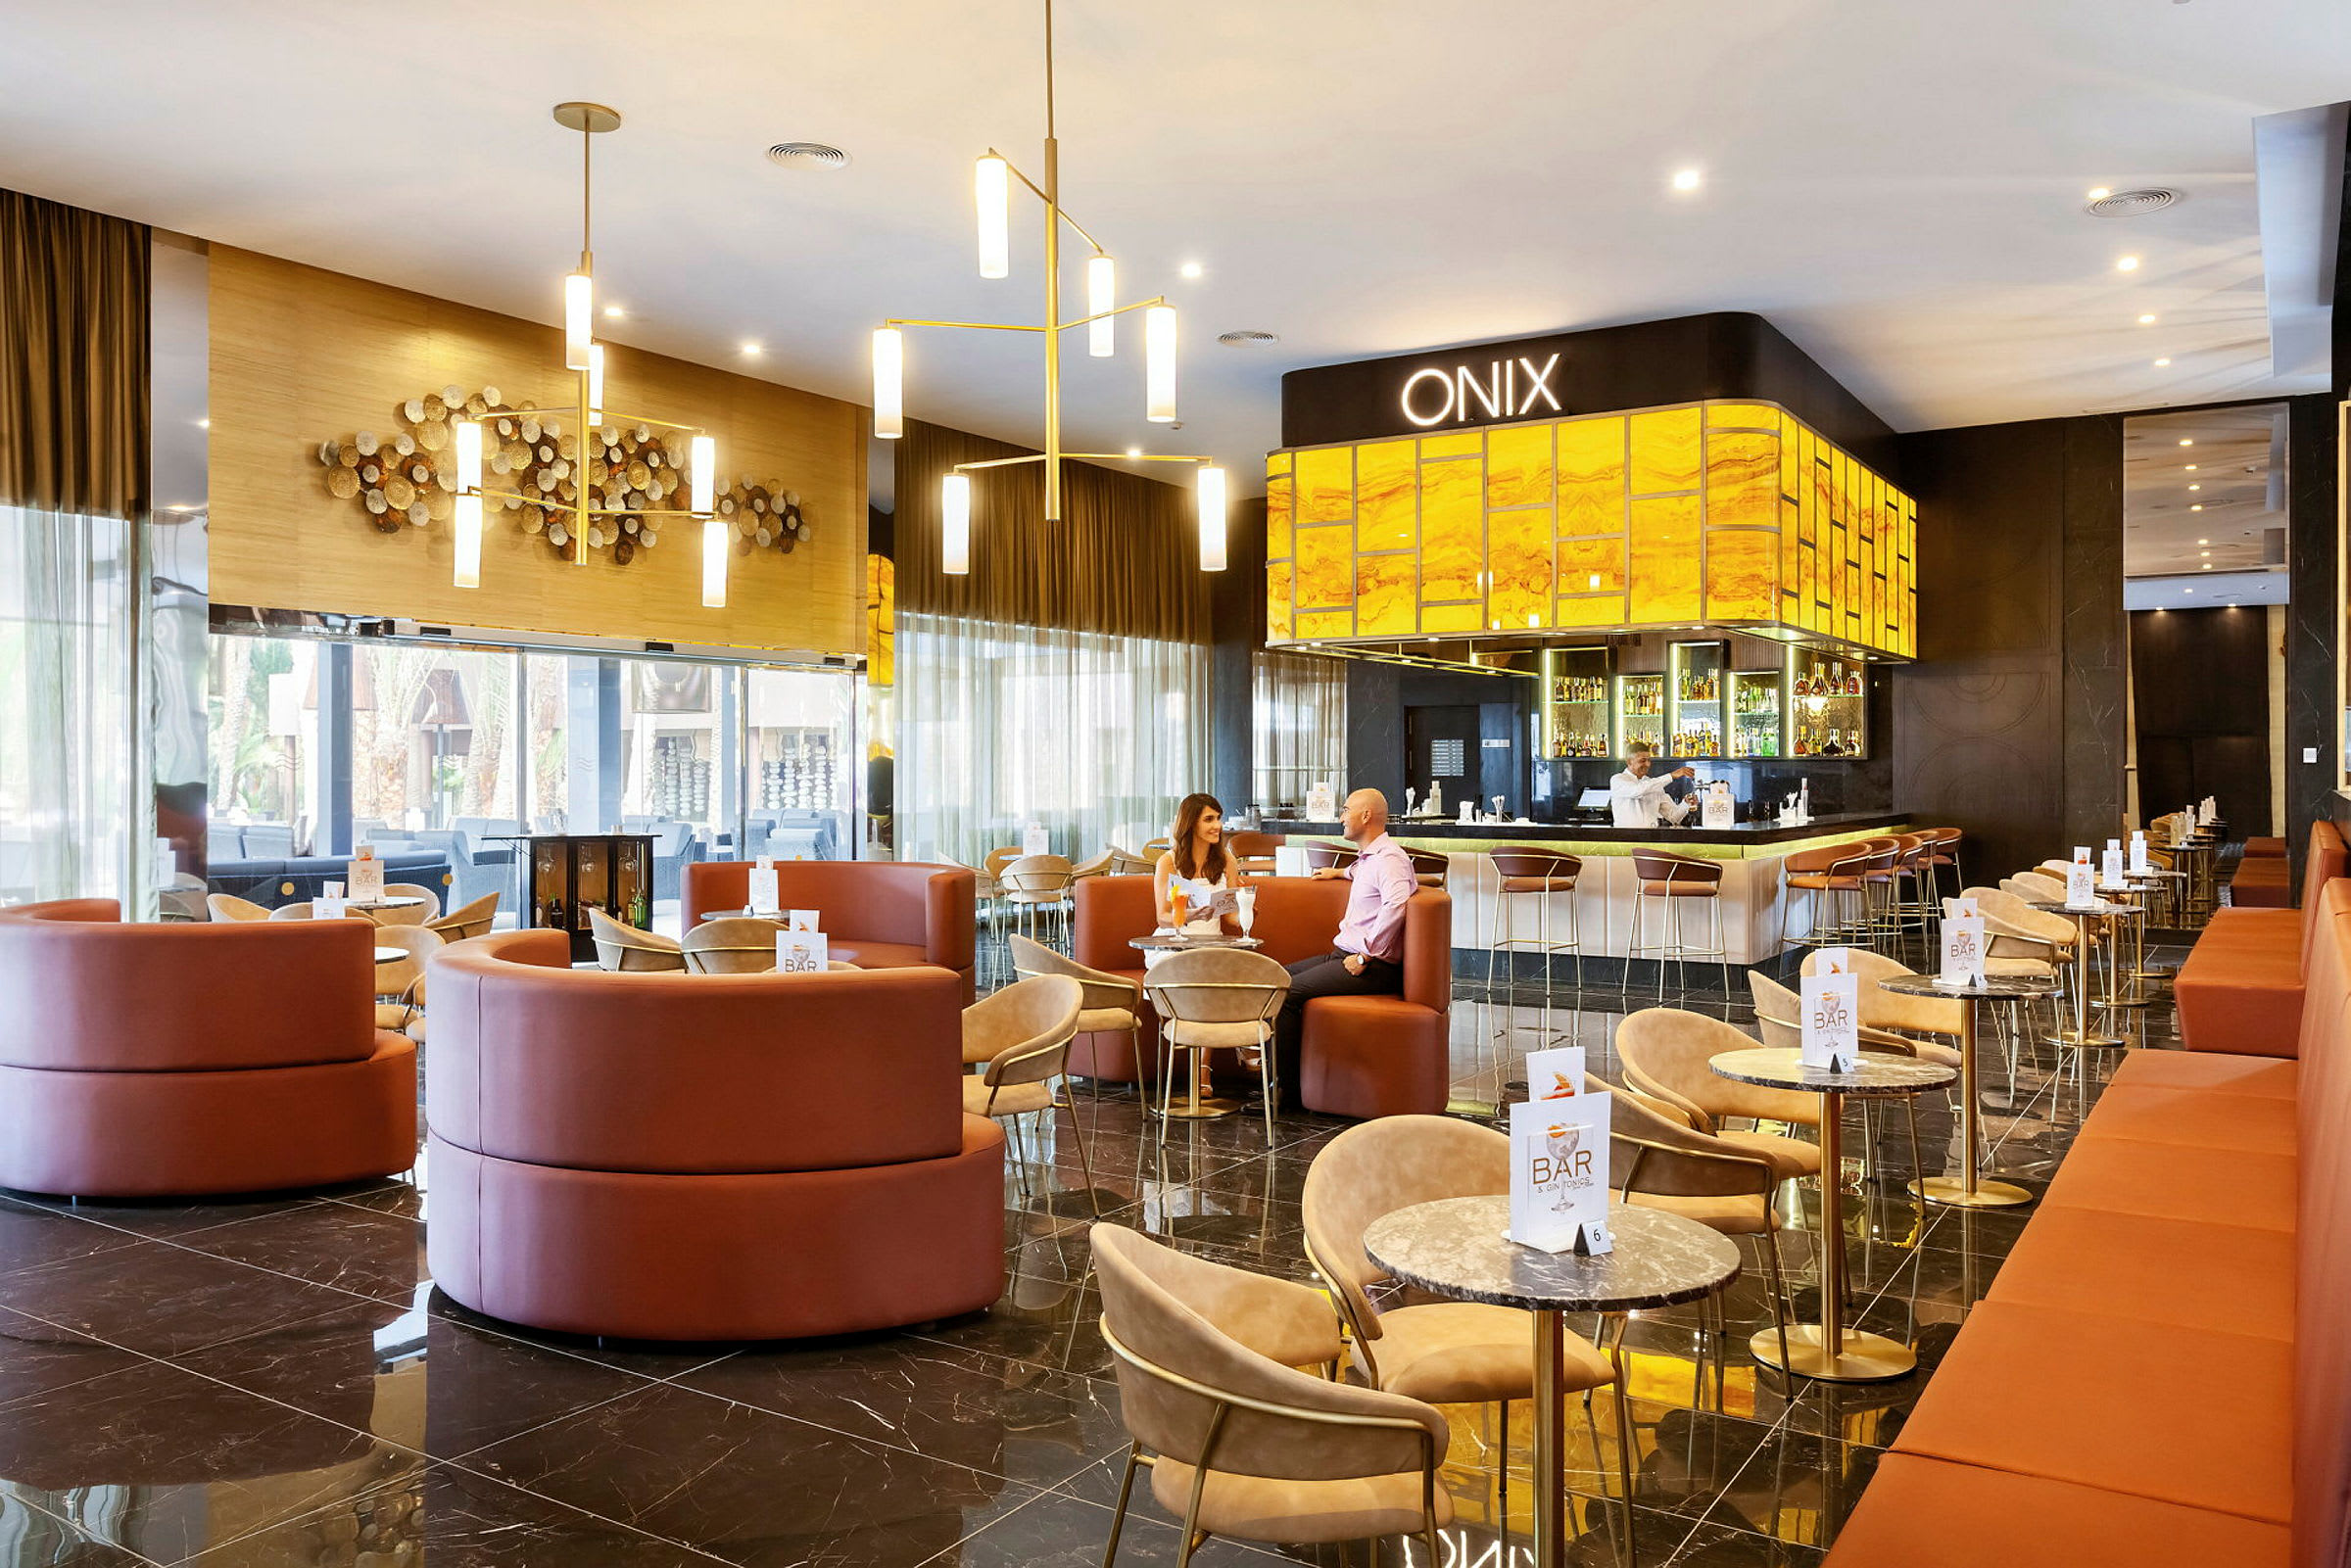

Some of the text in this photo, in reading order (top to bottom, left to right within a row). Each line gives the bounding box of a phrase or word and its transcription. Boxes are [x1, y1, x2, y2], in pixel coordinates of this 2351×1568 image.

[1402, 353, 1562, 426] ONIX
[355, 876, 378, 885] BAR
[1950, 943, 1976, 958] BAR
[785, 958, 818, 973] BAR
[1814, 1009, 1848, 1029] BAR
[1842, 1058, 1848, 1067] 5
[1533, 1150, 1592, 1185] BAR
[1593, 1228, 1602, 1242] 6
